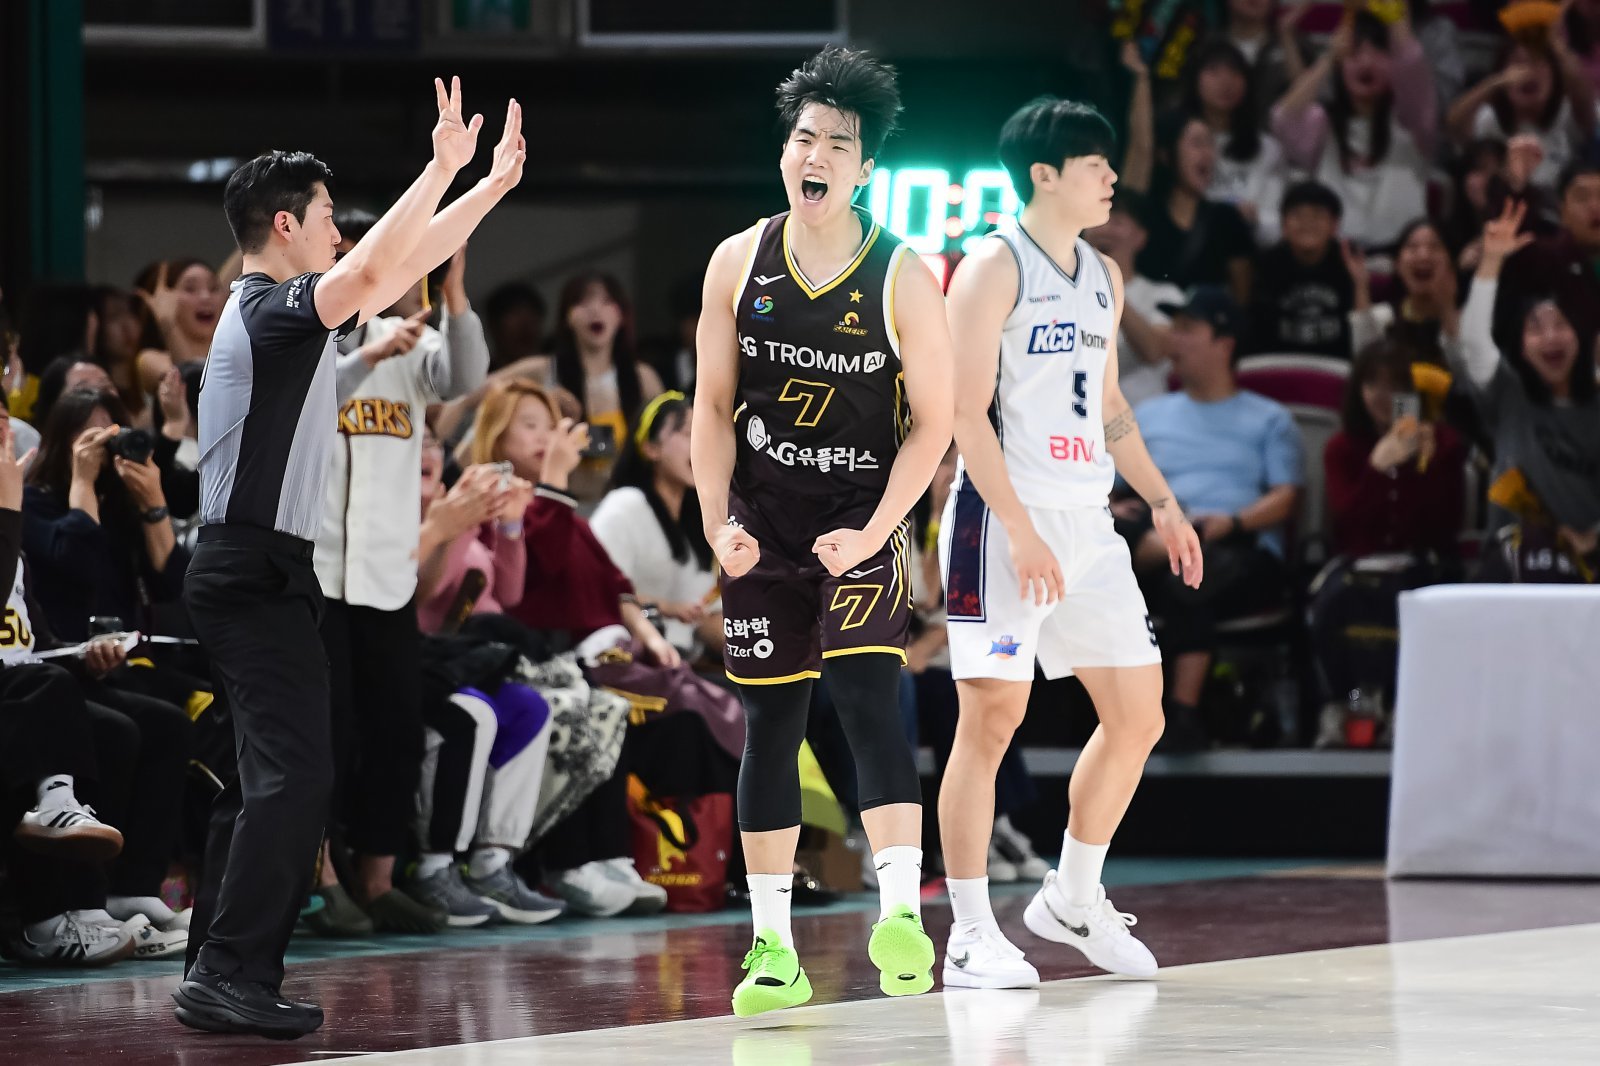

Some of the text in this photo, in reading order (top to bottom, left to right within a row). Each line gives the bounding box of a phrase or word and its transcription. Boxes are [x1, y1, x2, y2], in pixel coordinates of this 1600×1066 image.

[764, 340, 861, 373] TROMM
[1029, 321, 1075, 353] KCC
[778, 378, 836, 427] 7
[1071, 370, 1088, 419] 5
[829, 584, 884, 631] 7
